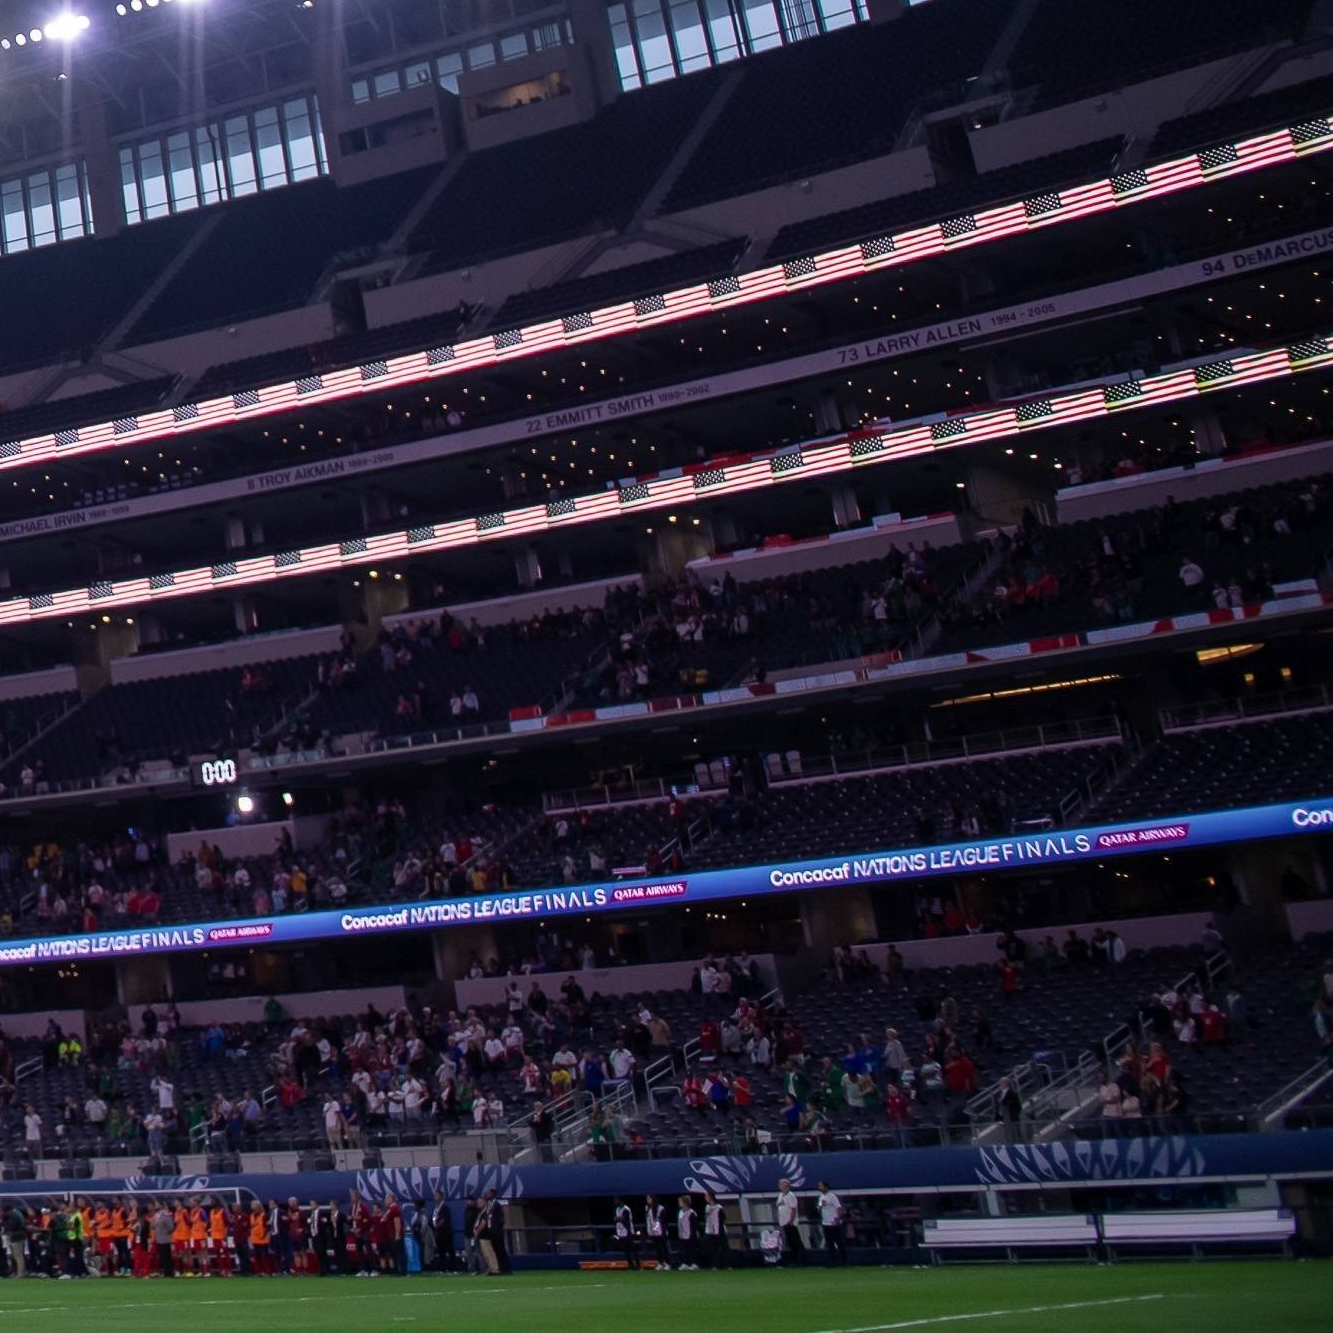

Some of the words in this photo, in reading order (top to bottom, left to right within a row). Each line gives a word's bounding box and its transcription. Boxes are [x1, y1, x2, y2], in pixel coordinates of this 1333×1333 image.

[1202, 260, 1225, 276] 94
[837, 349, 859, 364] 73
[866, 333, 920, 358] LARRY
[926, 319, 981, 344] ALLEN
[526, 420, 541, 433] 22
[546, 406, 603, 429] EMMITT
[608, 394, 654, 415] SMITH
[258, 471, 291, 488] TROY
[294, 461, 344, 480] AIKMAN
[0, 519, 52, 537] MICHAEL
[54, 512, 86, 528] IRVIN
[769, 863, 849, 887] Concacaf
[854, 853, 927, 878] NATIONS
[930, 844, 999, 869] LEAGUE
[1002, 834, 1091, 861] FINALS
[1099, 831, 1136, 846] QATAR
[1137, 826, 1186, 841] AIRWAYS
[341, 908, 407, 930] Concacaf
[410, 902, 471, 924] NATIONS
[474, 896, 532, 917] LEAGUE
[533, 888, 607, 912] FINALS
[614, 887, 645, 901] QATAR
[38, 938, 91, 957] NATIONS
[92, 934, 141, 953] LEAGUE
[141, 928, 204, 948] FINALS
